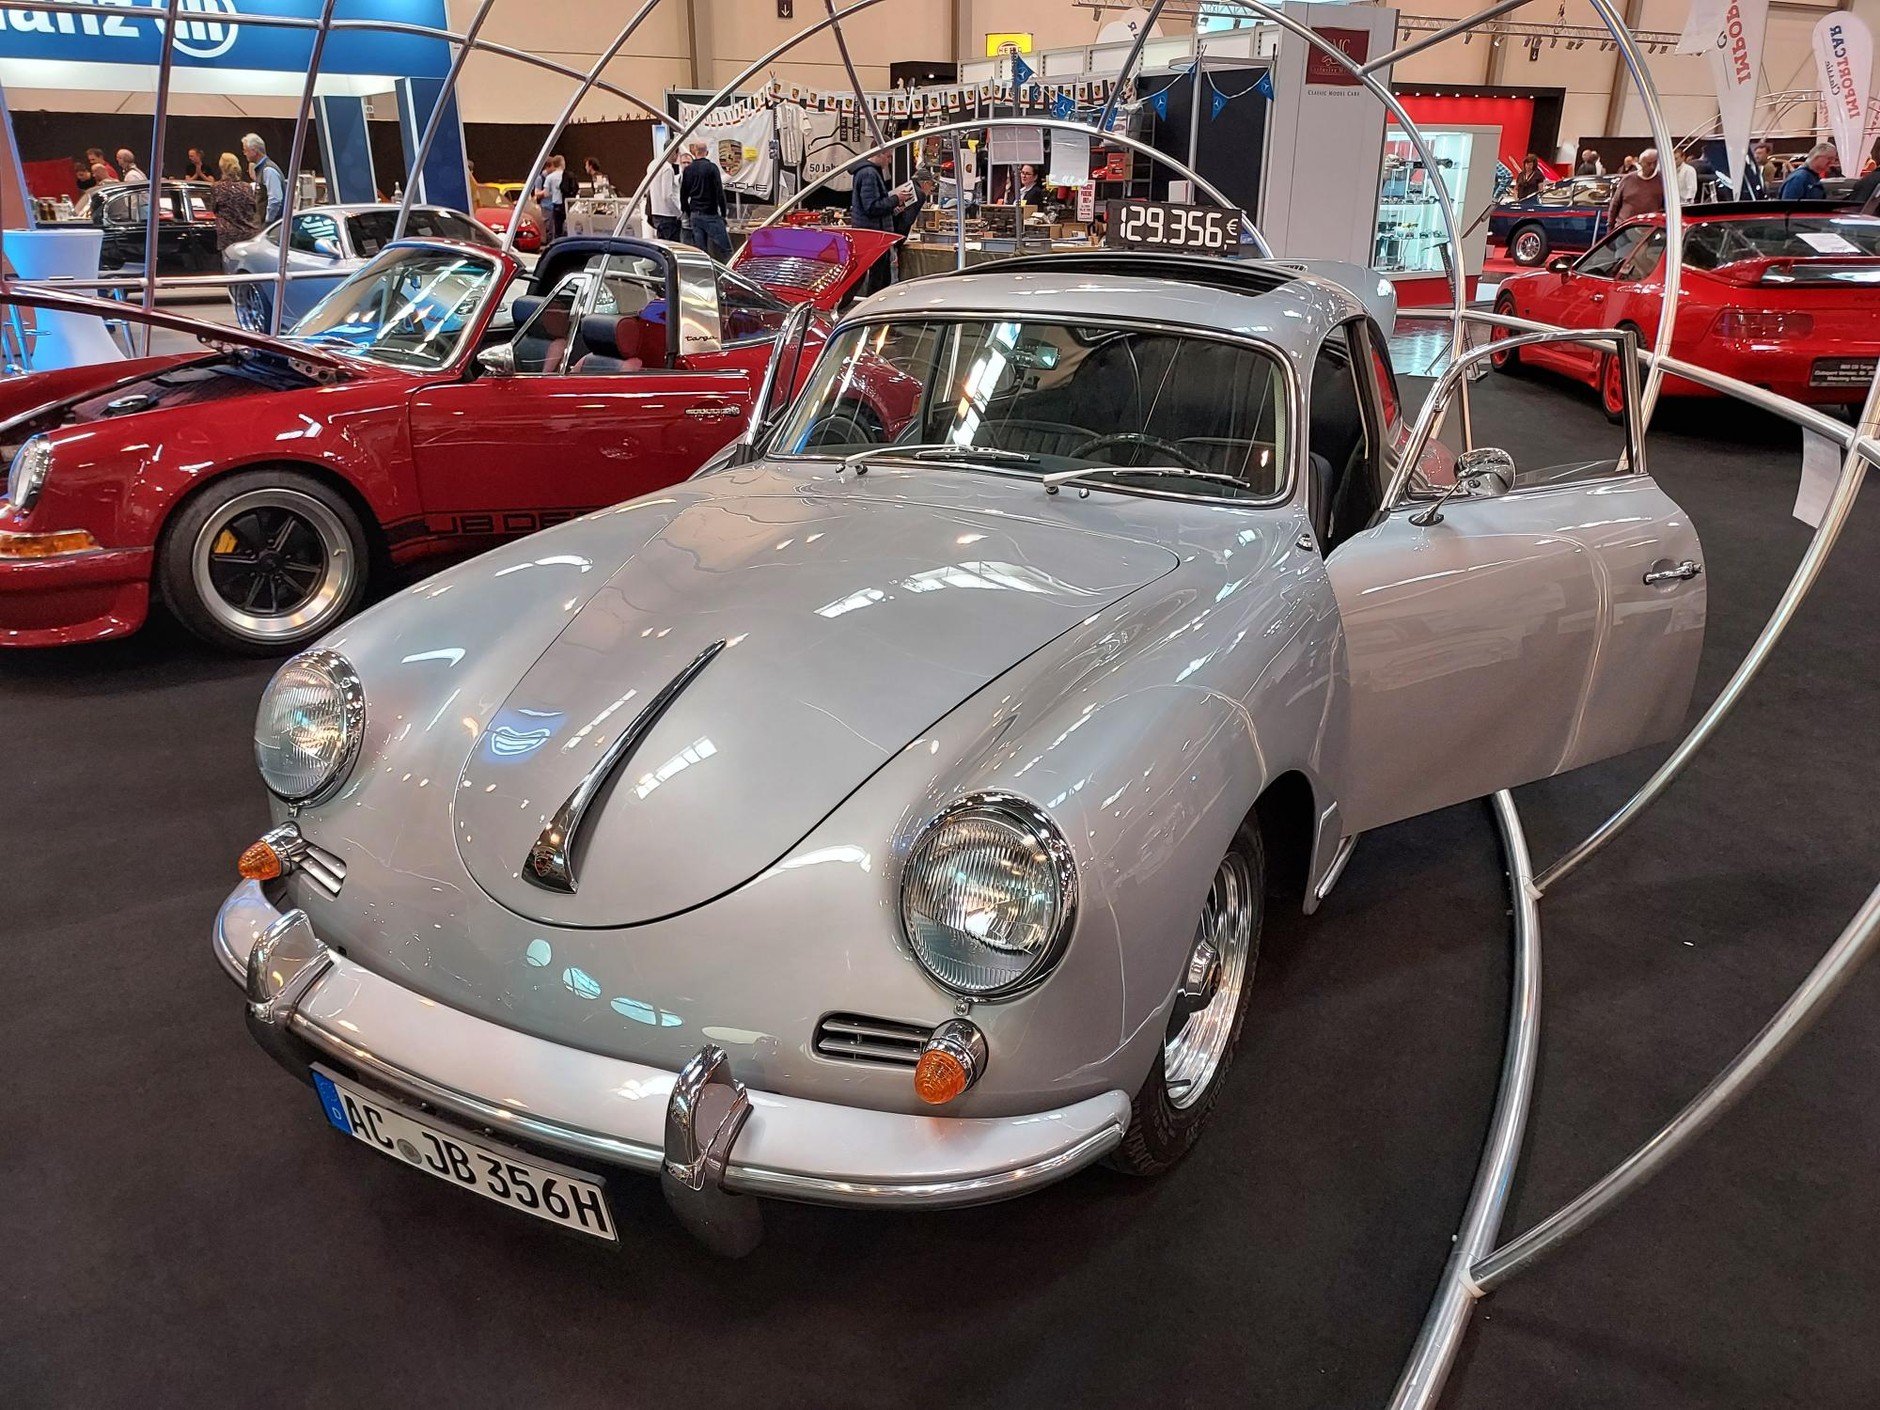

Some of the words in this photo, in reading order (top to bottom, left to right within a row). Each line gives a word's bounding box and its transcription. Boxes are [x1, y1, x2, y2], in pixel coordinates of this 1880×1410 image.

[809, 163, 820, 173] 50
[343, 1093, 395, 1150] AC
[421, 1131, 477, 1185] JB
[478, 1153, 609, 1234] 356H
